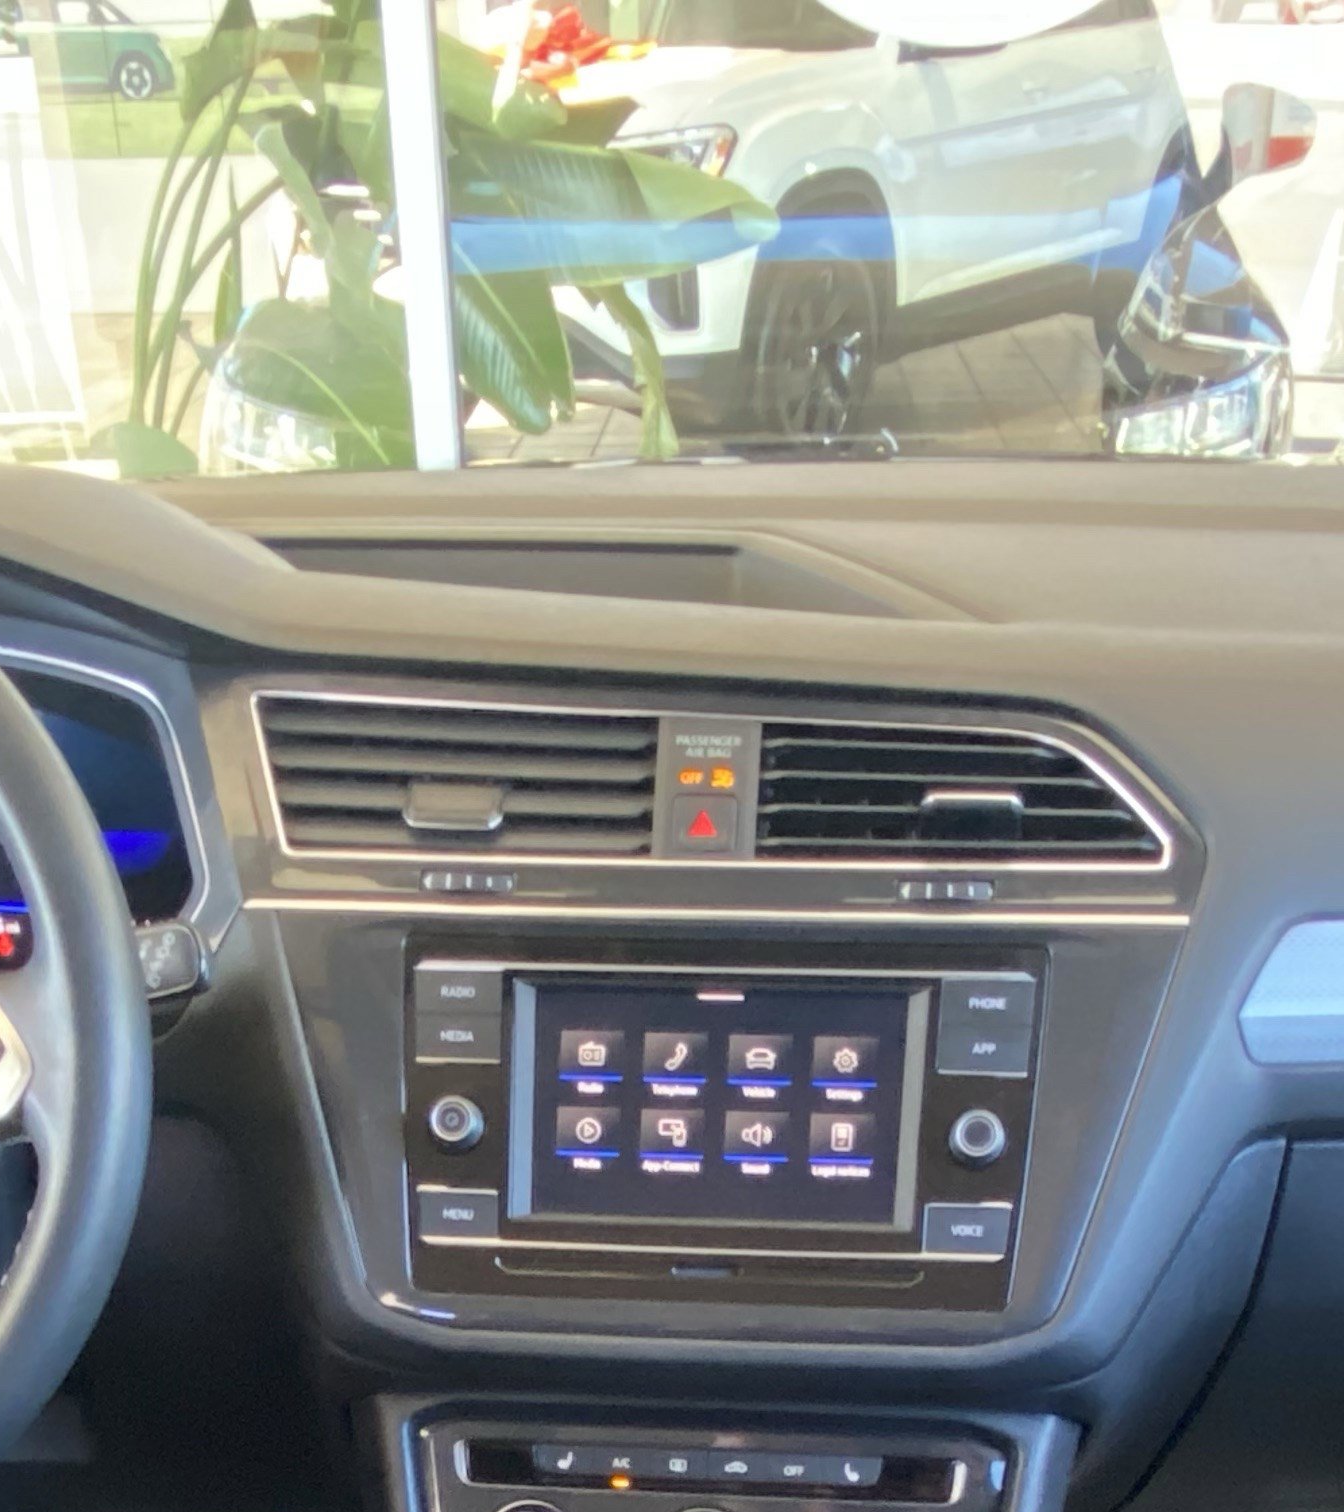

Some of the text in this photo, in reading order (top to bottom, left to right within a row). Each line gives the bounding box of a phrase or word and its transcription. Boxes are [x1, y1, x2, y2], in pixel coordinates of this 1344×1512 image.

[675, 735, 742, 746] PASSENGER
[708, 748, 732, 758] BAG
[679, 770, 704, 784] OFF
[440, 985, 476, 998] RADIO
[968, 996, 1007, 1011] PHONE
[439, 1030, 475, 1042] MEDIA
[972, 1042, 997, 1056] APP
[442, 1208, 474, 1221] MENU
[950, 1224, 984, 1238] VOICE
[611, 1457, 631, 1469] A/C
[783, 1464, 805, 1477] OFF
